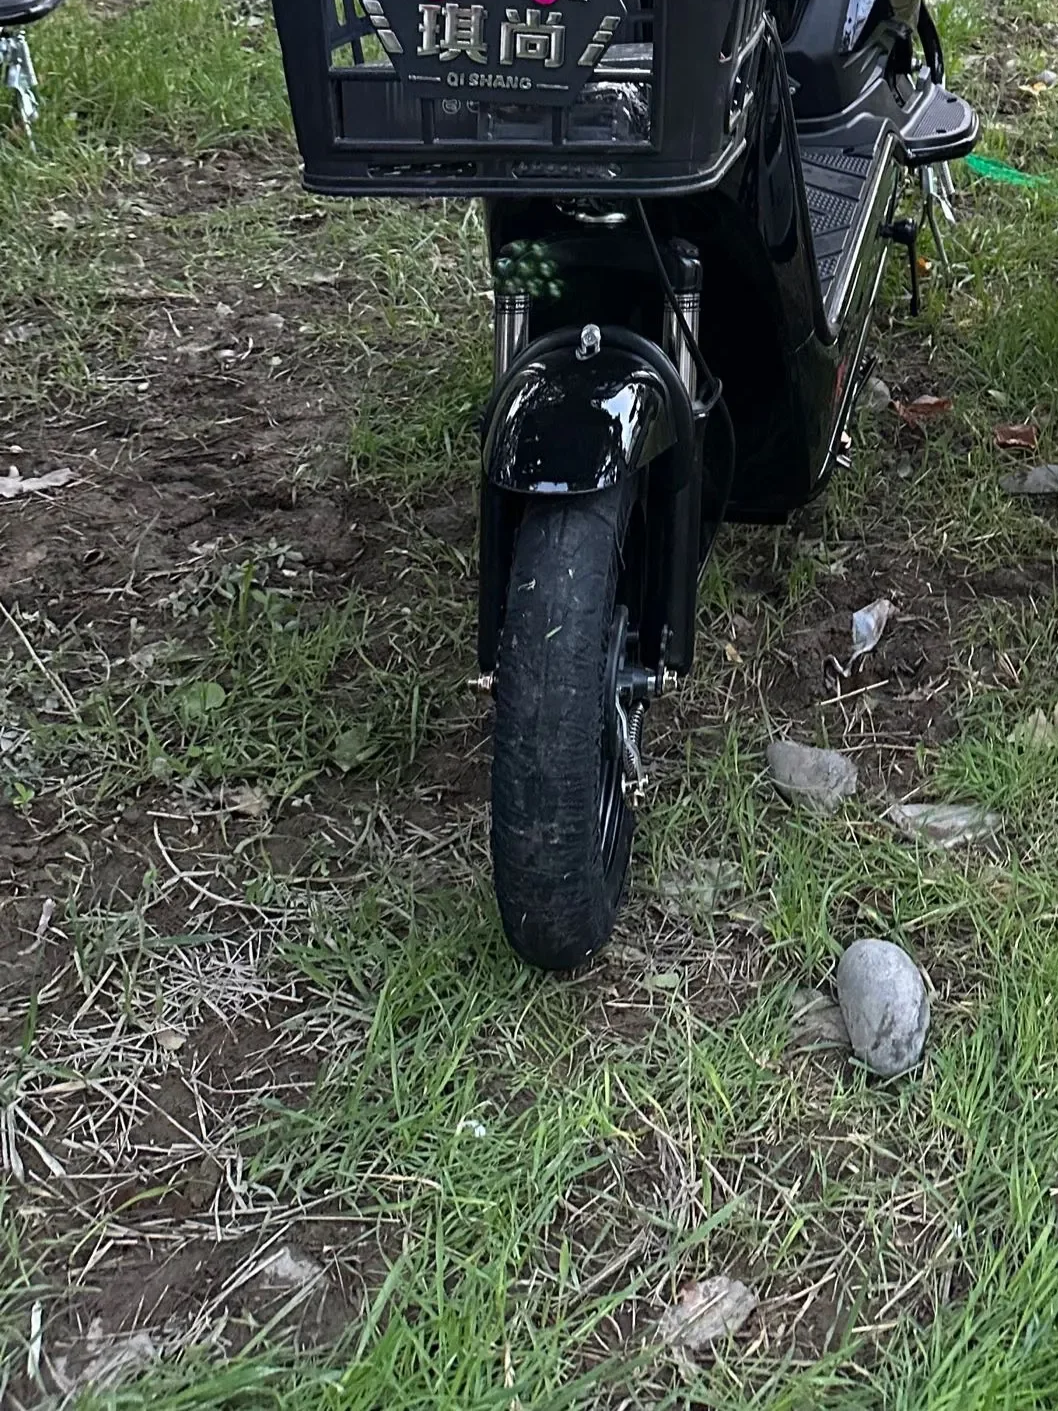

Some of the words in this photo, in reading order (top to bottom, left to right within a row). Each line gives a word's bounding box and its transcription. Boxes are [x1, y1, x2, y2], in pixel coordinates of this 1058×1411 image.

[416, 2, 567, 68] 琪尚
[446, 71, 465, 88] QI
[468, 72, 533, 91] SHANG
